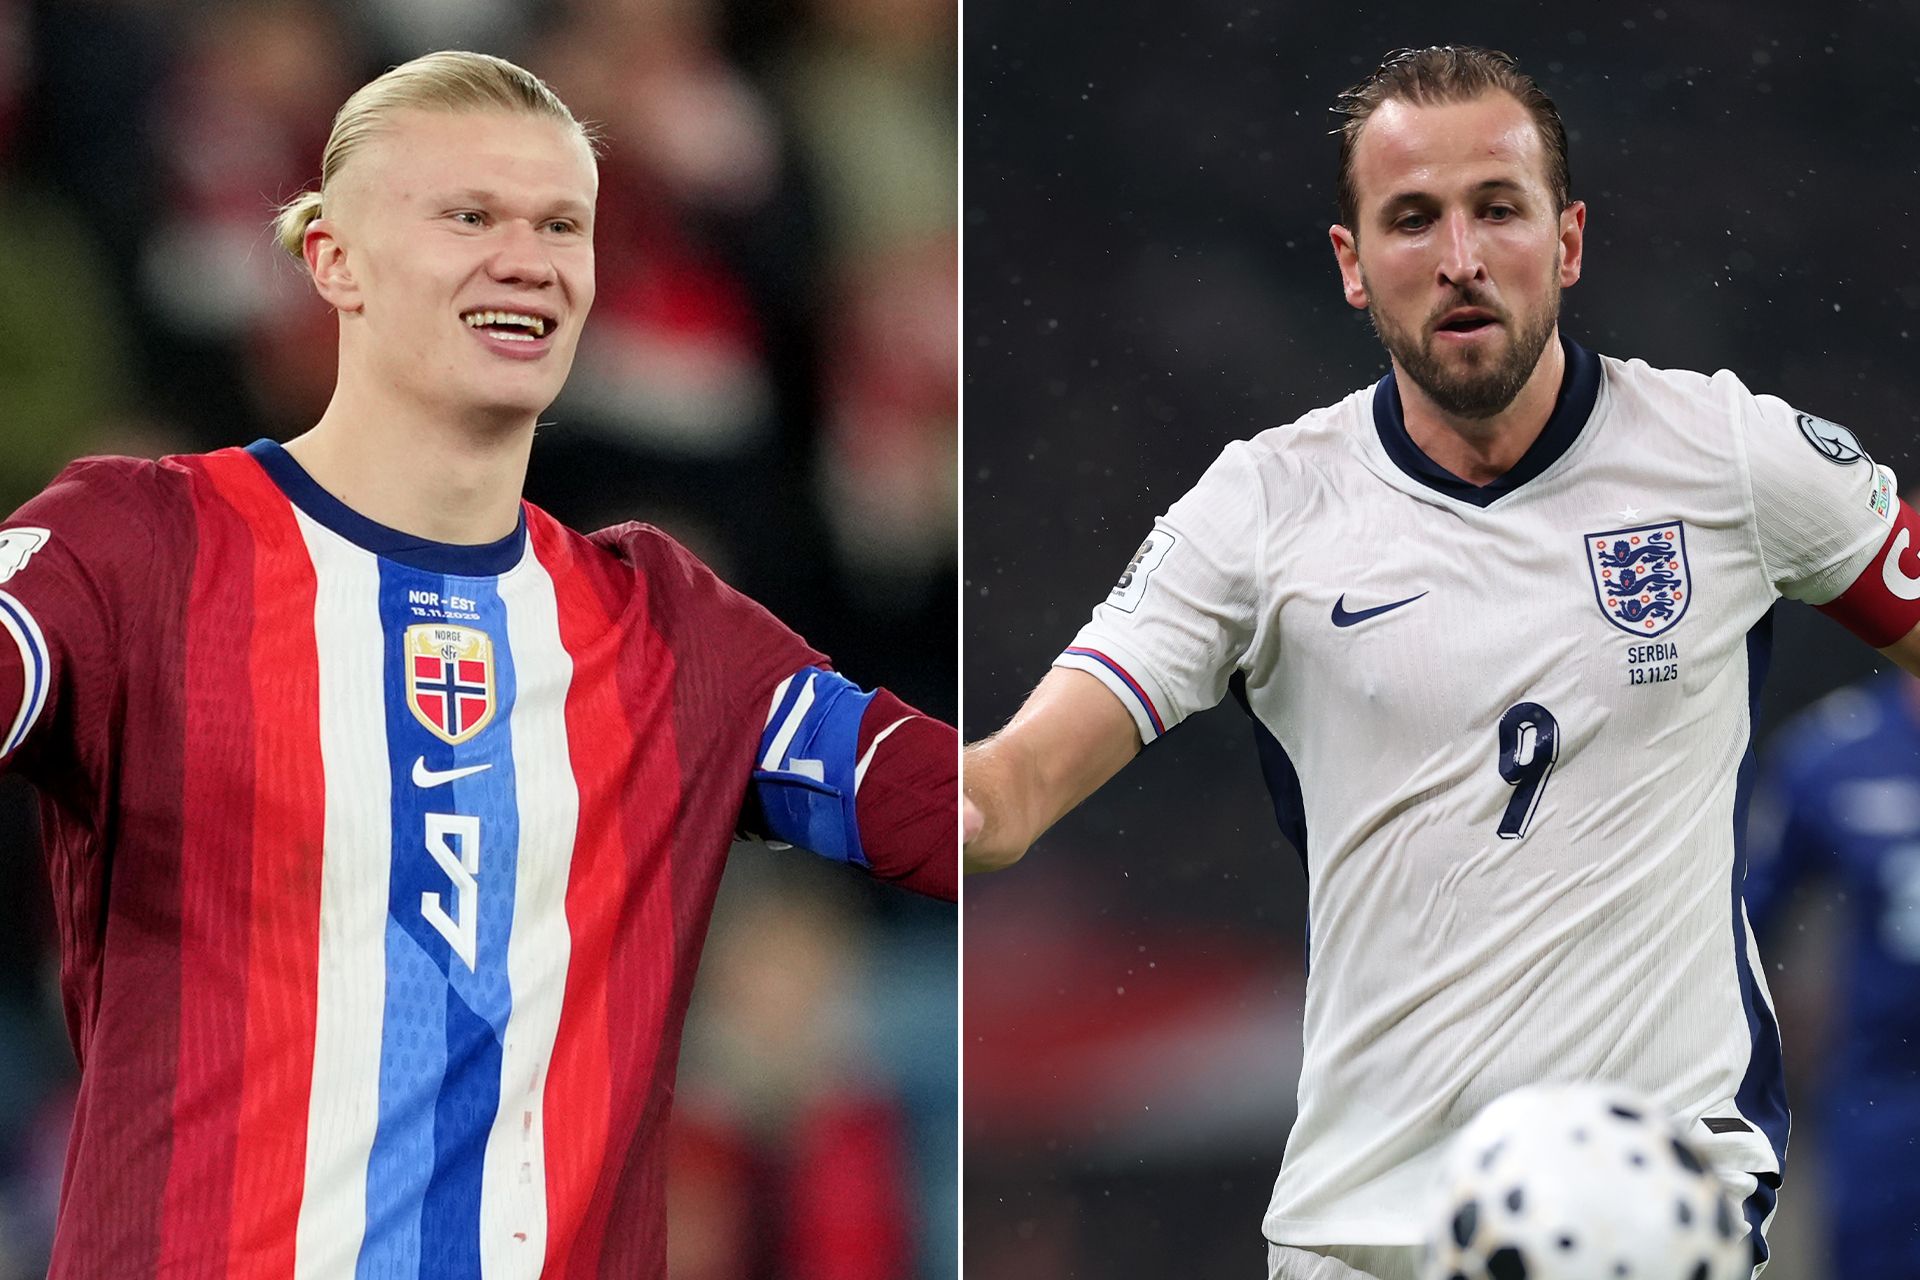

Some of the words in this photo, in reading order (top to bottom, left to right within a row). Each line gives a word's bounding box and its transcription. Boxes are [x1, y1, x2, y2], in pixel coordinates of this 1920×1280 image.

[408, 590, 439, 606] NOR
[451, 596, 476, 612] EST
[435, 629, 461, 641] NORGE
[1627, 642, 1679, 664] SERBIA
[1628, 664, 1679, 685] 13.11.25
[1497, 702, 1559, 840] 9
[421, 813, 480, 974] 9
